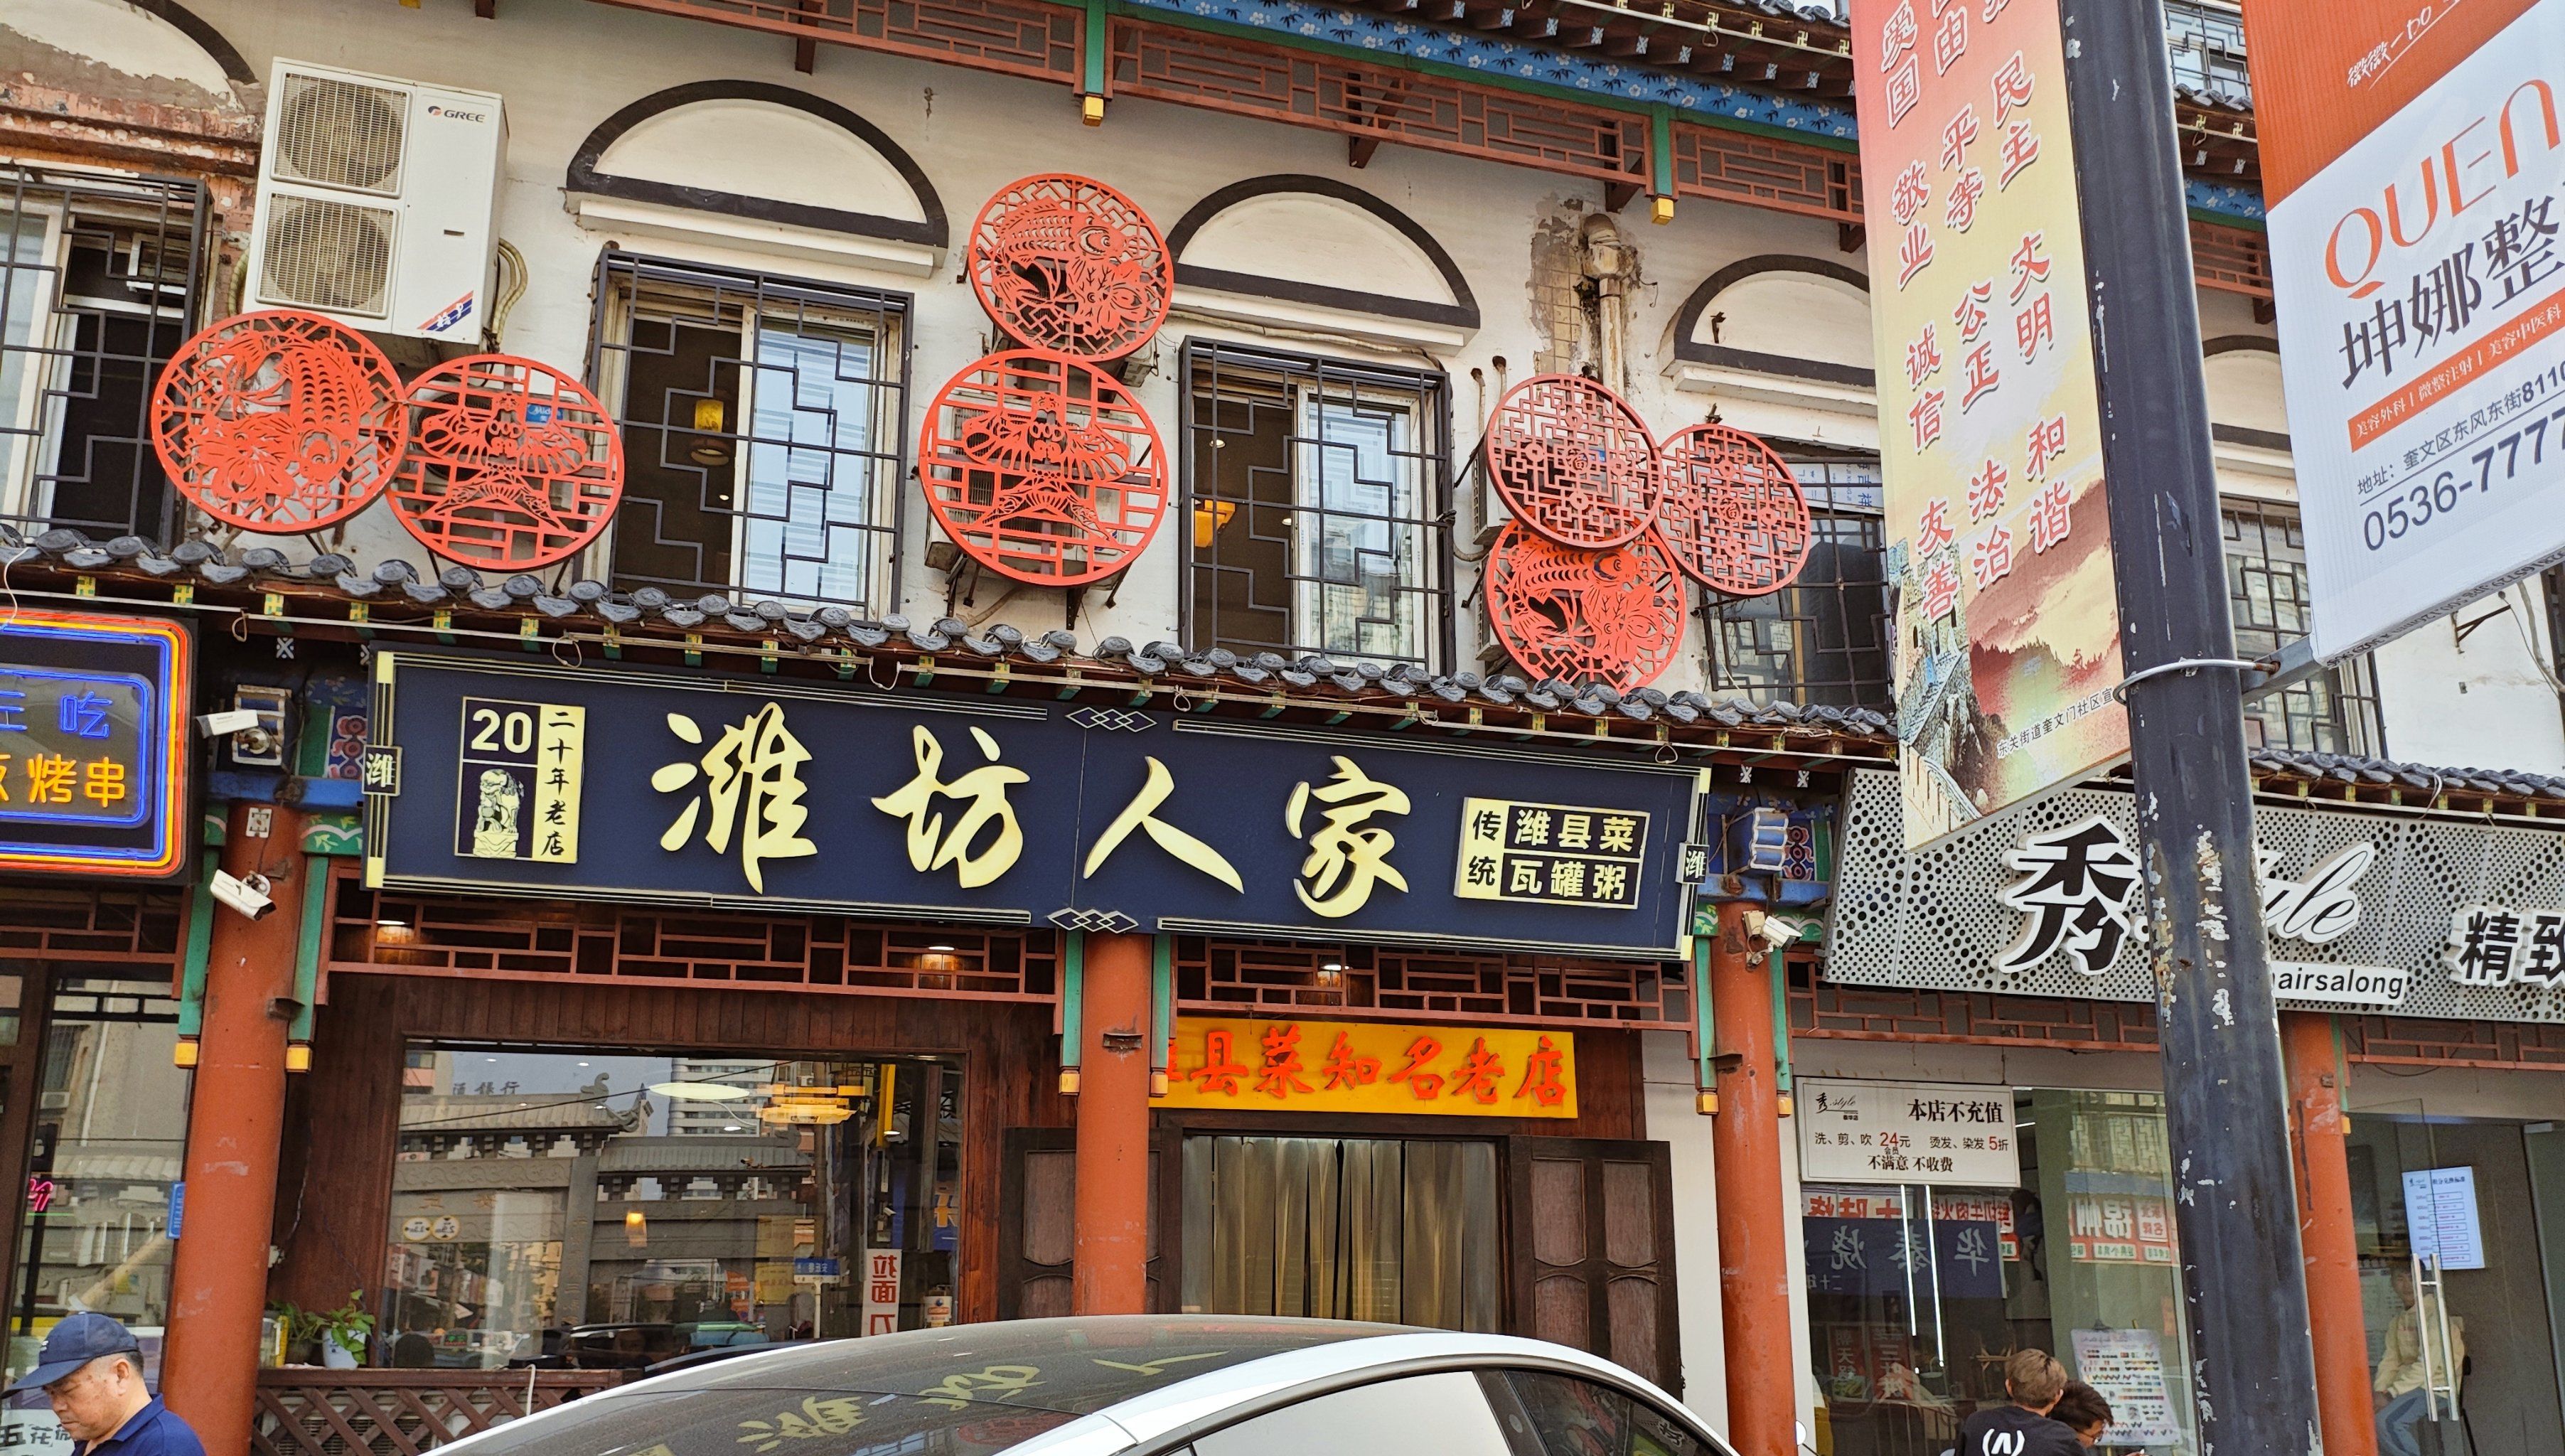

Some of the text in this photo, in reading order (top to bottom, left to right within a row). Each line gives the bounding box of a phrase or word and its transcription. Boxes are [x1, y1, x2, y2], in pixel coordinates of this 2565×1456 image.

[444, 109, 486, 124] GREE
[1990, 50, 2041, 193] 民主
[1892, 159, 1936, 291] 敬业
[1930, 0, 2013, 591] 由 平等 公正 法治
[2008, 229, 2053, 363] 文明
[2339, 195, 2565, 390] 坤娜整
[1904, 320, 1946, 452] 诚信
[2026, 411, 2074, 555] 和谐
[1915, 495, 1960, 626] 友善
[471, 708, 533, 754] 20
[1997, 687, 2114, 759] 东关街道奎文门社区宣
[0, 754, 125, 808] 烤串
[365, 753, 395, 788] 潍
[541, 711, 576, 857] 二十年老店
[650, 701, 1411, 918] 潍坊人家
[1514, 809, 1637, 853] 潍县菜
[1467, 810, 1501, 887] 传统
[1509, 858, 1628, 901] 瓦罐粥
[1685, 850, 1706, 879] 潍
[2001, 818, 2140, 974] 秀
[2272, 967, 2404, 1000] airsalong
[1880, 1132, 1911, 1147] 24元
[1988, 1135, 2008, 1152] 5折
[1907, 1099, 2005, 1123] 本店不充值
[1868, 1154, 1954, 1172] 不满意 不收费
[1884, 1146, 1900, 1155] 会员
